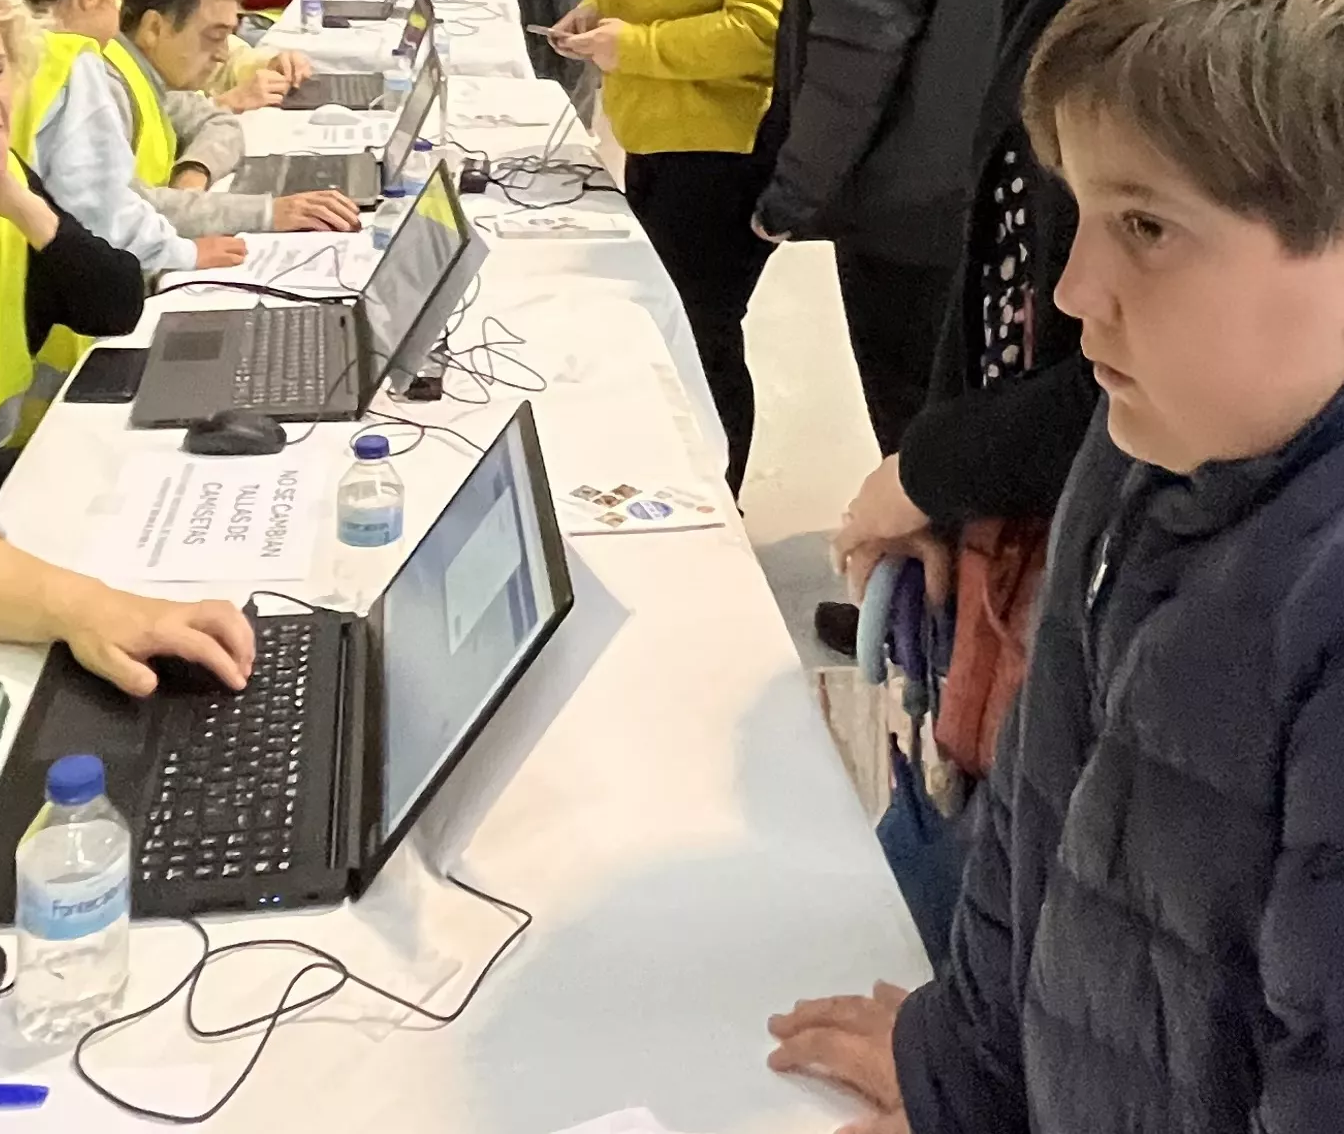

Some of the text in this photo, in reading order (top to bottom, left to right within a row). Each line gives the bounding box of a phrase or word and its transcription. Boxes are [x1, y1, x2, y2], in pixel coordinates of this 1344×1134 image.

[276, 470, 299, 486] NO
[182, 481, 223, 545] CAMISETAS
[224, 484, 260, 542] TALLAS DE
[260, 503, 293, 558] CAMBIAN
